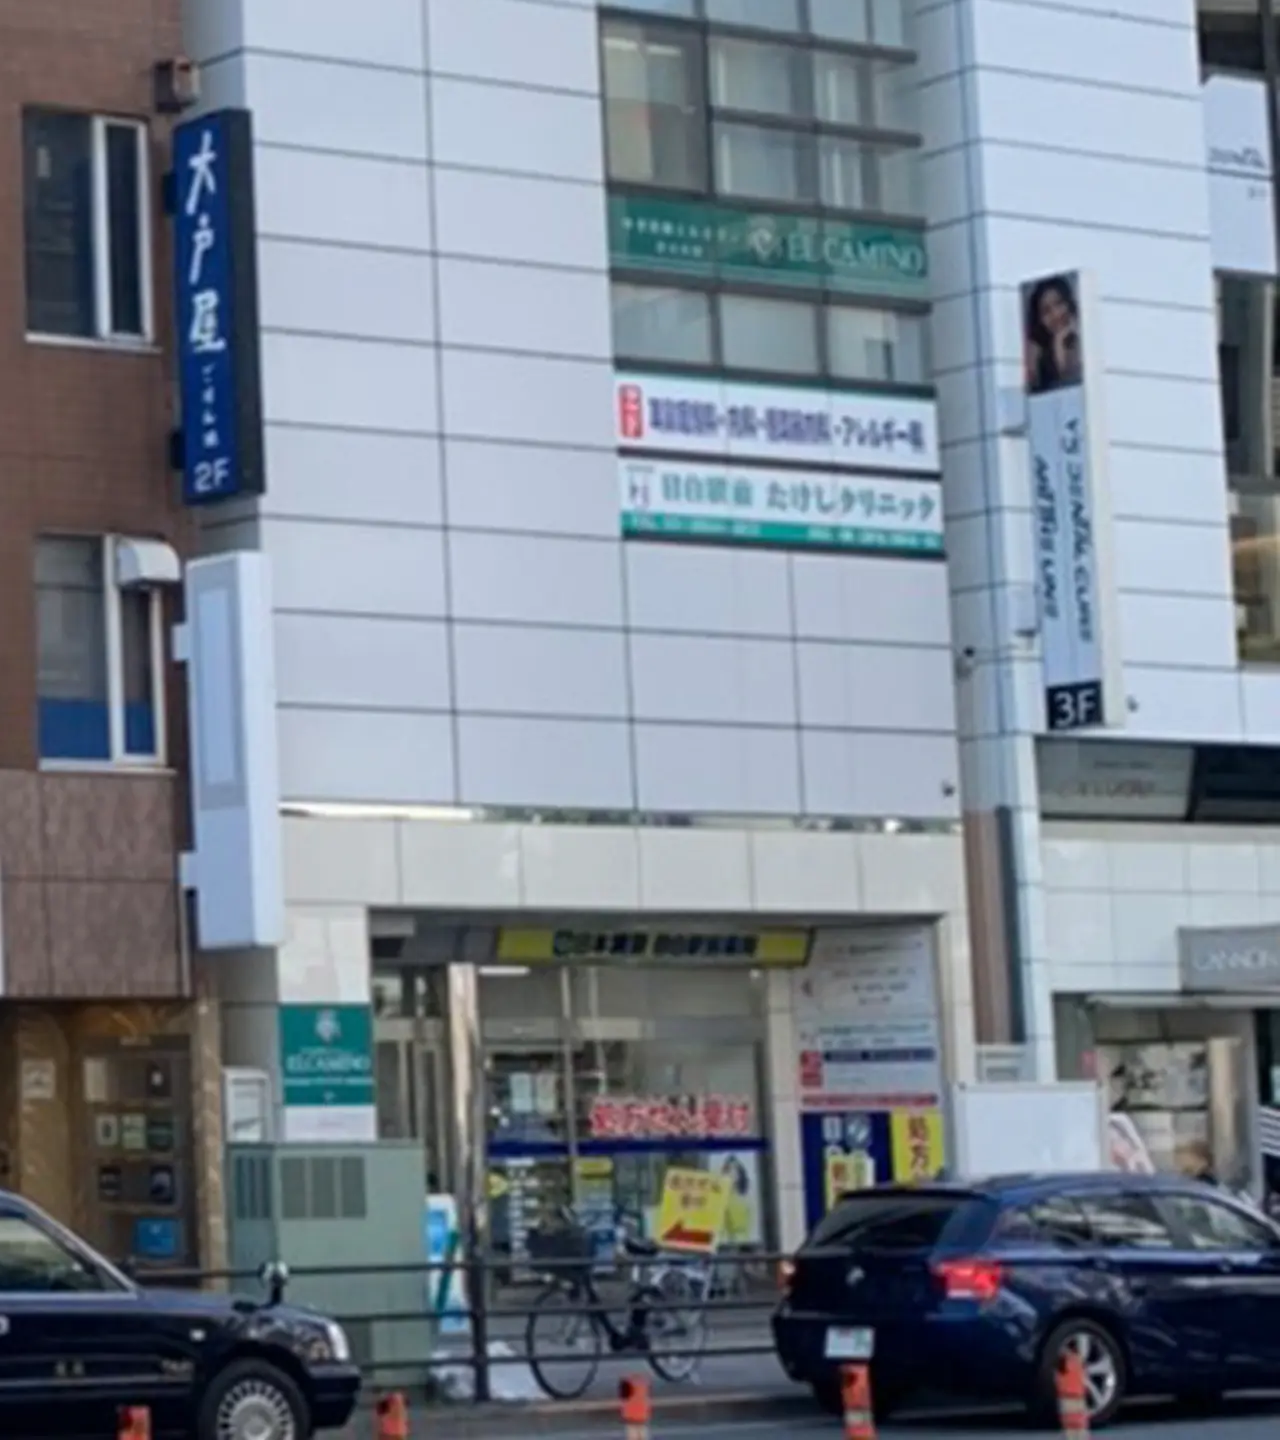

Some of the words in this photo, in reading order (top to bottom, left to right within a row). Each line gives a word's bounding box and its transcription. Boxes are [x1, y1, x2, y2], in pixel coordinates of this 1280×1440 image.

[186, 128, 227, 353] 大戸屋
[193, 456, 231, 492] 2F
[1052, 688, 1099, 729] 3F
